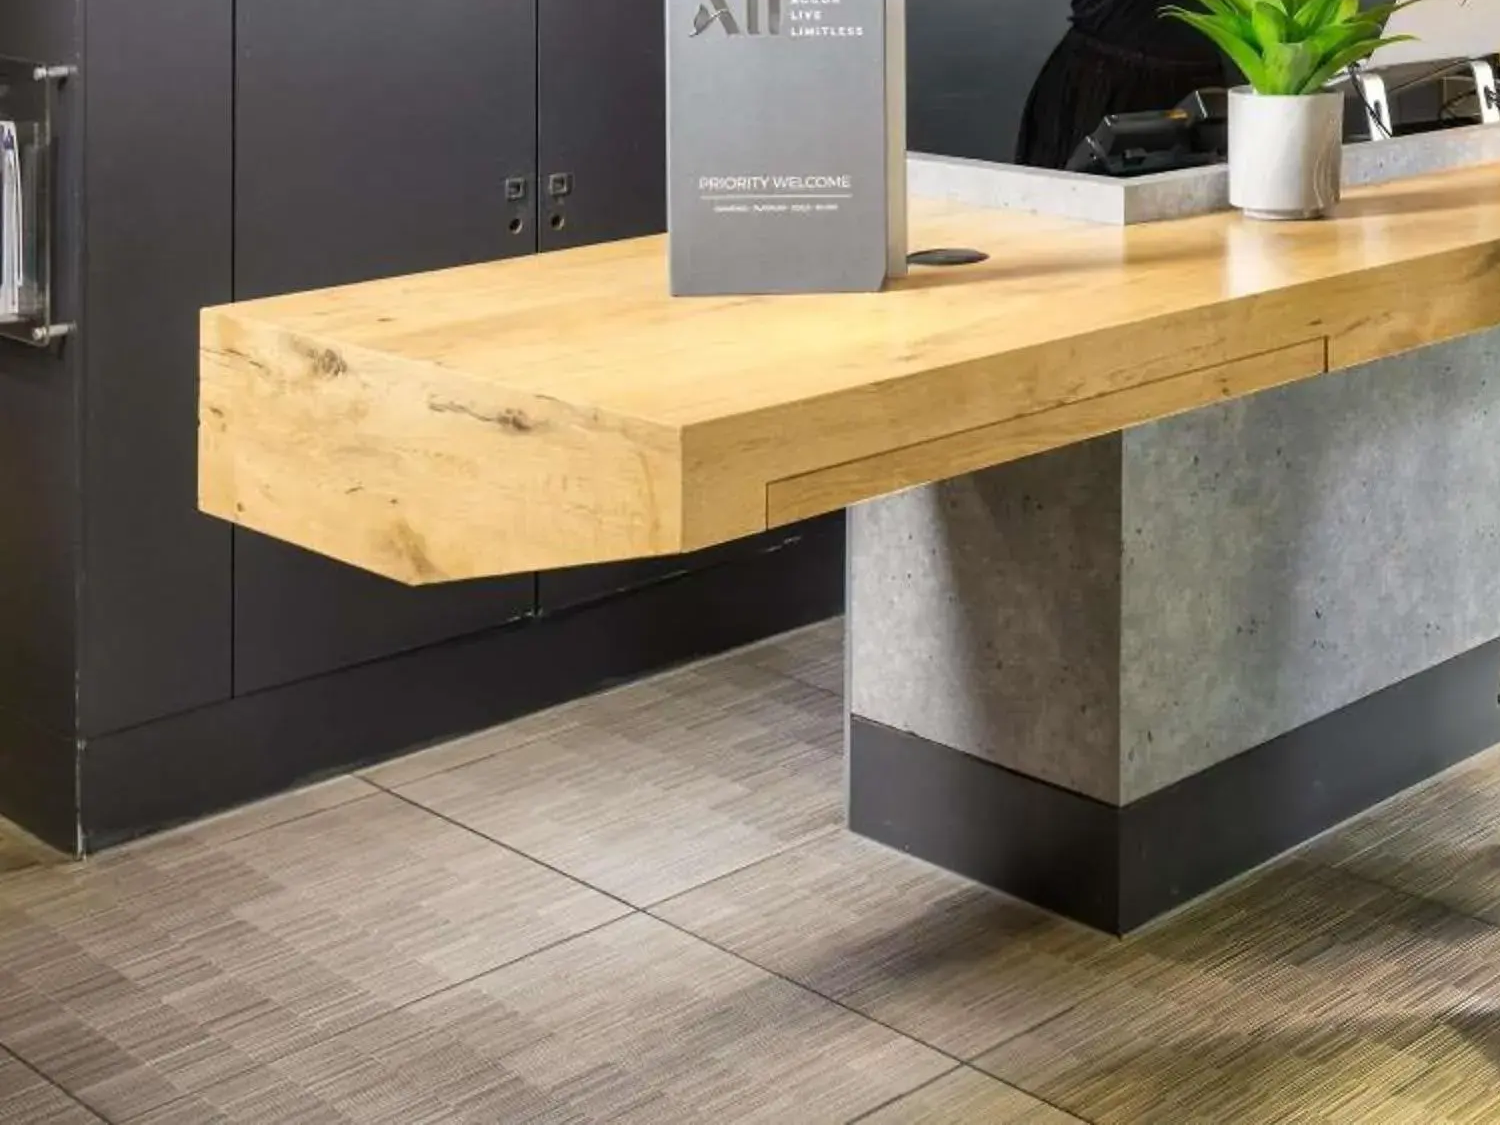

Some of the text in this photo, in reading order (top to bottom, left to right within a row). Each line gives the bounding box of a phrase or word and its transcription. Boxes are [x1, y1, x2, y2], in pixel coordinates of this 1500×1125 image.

[790, 10, 823, 21] LIVE
[790, 26, 864, 37] LIMITLESS
[698, 174, 852, 191] PRIORITY WELCOME
